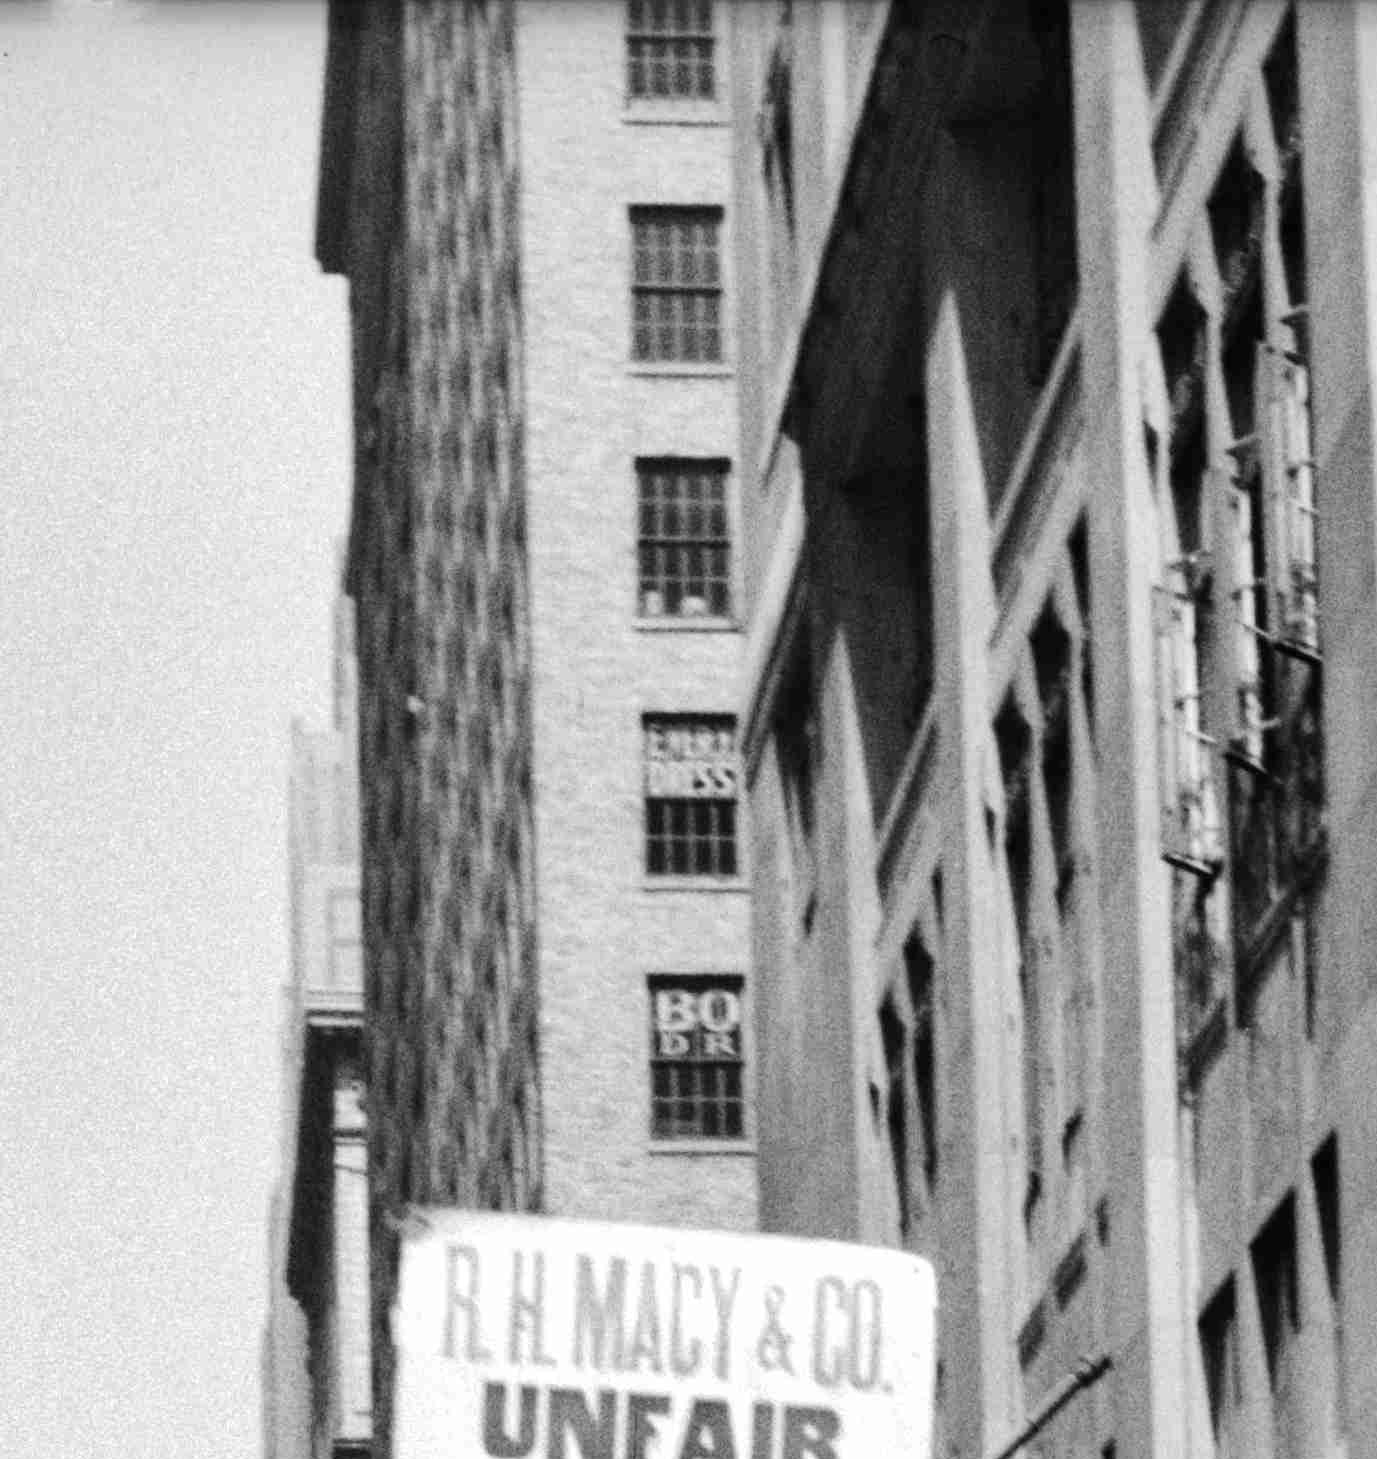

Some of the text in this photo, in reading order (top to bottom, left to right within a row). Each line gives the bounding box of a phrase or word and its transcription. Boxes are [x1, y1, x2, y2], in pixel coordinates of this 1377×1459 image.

[441, 1243, 894, 1394] R. H. MACY & CO.
